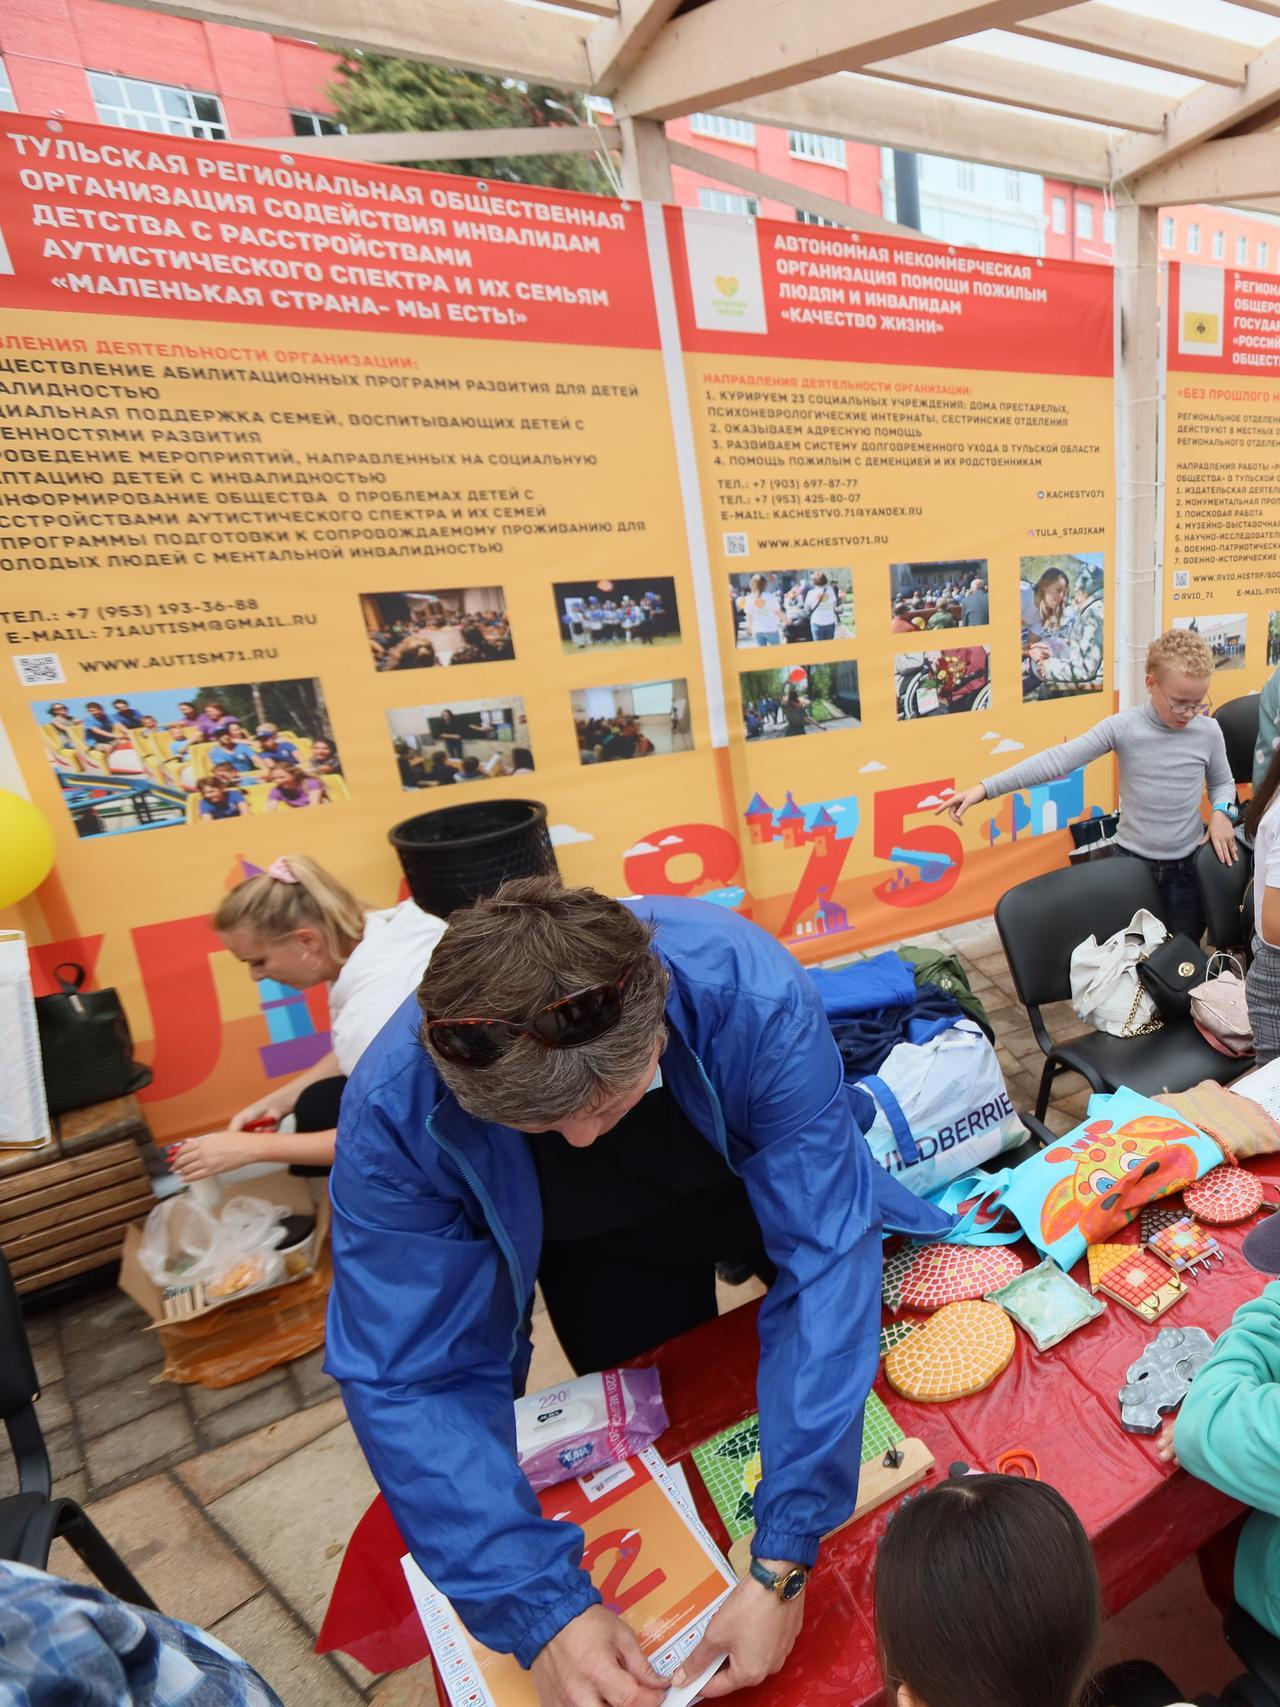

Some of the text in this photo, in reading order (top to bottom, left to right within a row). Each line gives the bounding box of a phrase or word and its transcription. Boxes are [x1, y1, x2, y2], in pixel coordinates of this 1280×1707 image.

[7, 133, 625, 230] ТУЛЬСКАЯ РЕГИОНАЛЬНАЯ ОБЩЕСТВЕННАЯ
[20, 168, 600, 253] ОРГАНИЗАЦИЯ СОДЕЙСТВИЯ ИНВАЛИДАМ
[32, 203, 472, 268] ДЕТСТВА С РАССТРОЙСТВАМИ
[774, 233, 1032, 281] АВТОНОМНАЯ НЕКОММЕРЧЕСКАЯ
[43, 238, 609, 306] АУТИСТИЧЕСКОГО СПЕКТРА И ИХ СЕМЬЯМ
[776, 258, 1048, 303] ОРГАНИЗАЦИЯ ПОМОЩИ ПОЖИЛЫМ
[51, 272, 528, 325] «МАЛЕНЬКАЯ СТРАНА- МЫ ЕСТЬ!»
[779, 282, 962, 316] ЛЮДЯМ И ИНВАЛИДАМ
[781, 308, 944, 334] «КАЧЕСТВО ЖИЗНИ»
[96, 340, 419, 370] ДЕЯТЕЛЬНОСТИ ОРГАНИЗАЦИИ:
[164, 367, 639, 397] АБИЛИТАЦИОННЫХ ПРОГРАММ РАЗВИТИЯ ДЛЯ ДЕТЕЙ
[703, 373, 973, 396] НАПРАВЛЕНИЯ ДЕЯТЕЛЬНОСТИ ОРГАНИЗАЦИИ:
[720, 391, 1070, 415] КУРИРУЕМ 23 СОЦИАЛЬНЫХ УЧРЕЖДЕНИЯ: ДОМА ПРЕСТАРЕЛЫХ,
[1209, 389, 1270, 402] ПРОШЛОГО
[127, 408, 570, 431] ПОДДЕРЖКА СЕМЕЙ, ВОСПИТЫВАЮЩИХ ДЕТЕЙ
[708, 407, 1069, 427] ПСИХОНЕВРОЛОГИЧЕСКИЕ ИНТЕРНАТЫ, СЕСТРИНСКИЕ ОТДЕЛЕНИЯ
[152, 429, 262, 444] РАЗВИТИЯ
[724, 424, 923, 439] ОКАЗЫВАЕМ АДРЕСНУЮ ПОМОЩЬ
[140, 448, 598, 467] МЕРОПРИЯТИЙ, НАПРАВЛЕННЫХ СОЦИАЛЬНУЮ
[726, 440, 1100, 454] РАЗВИВАЕМ СИСТЕМУ ДОЛГОВРЕМЕННОГО УХОДА ТУЛЬСКОЙ ОБЛАСТИ
[728, 455, 1042, 468] ПОМОЩЬ ПОЖИЛЫМ ДЕМЕНЦИЕЙ РОДСТВЕННИКАМ
[112, 467, 387, 486] ДЕТЕЙ ИНВАЛИДНОСТЬЮ
[717, 478, 858, 491] ТЕЛ.: (903) 697-87-77
[217, 487, 519, 506] ОБЩЕСТВА ПРОБЛЕМАХ ДЕТЕЙ
[187, 509, 363, 525] АУТИСТИЧЕСКОГО
[368, 508, 446, 522] СПЕКТРА
[493, 505, 546, 518] СЕМЕЙ
[721, 509, 770, 521] E-MAIL:
[155, 531, 289, 547] ПОДГОТОВКИ
[313, 525, 496, 541] СОПРОВОЖДАЕМОМУ
[502, 521, 613, 536] ПРОЖИВАНИЮ
[618, 520, 646, 532] ДЛЯ
[107, 553, 187, 568] ЛЮДЕЙ
[213, 547, 344, 564] МЕНТАЛЬНОЙ
[350, 541, 504, 558] ИНВАЛИДНОСТЬЮ
[65, 607, 89, 621] +7
[97, 603, 152, 621] (953)
[158, 599, 259, 616] 193-36-88
[6, 613, 319, 645] E-MAIL: 71AUTISM@GMAIL.RU
[79, 648, 279, 674] WWW.AUTISM71.RU
[538, 1390, 567, 1410] 220
